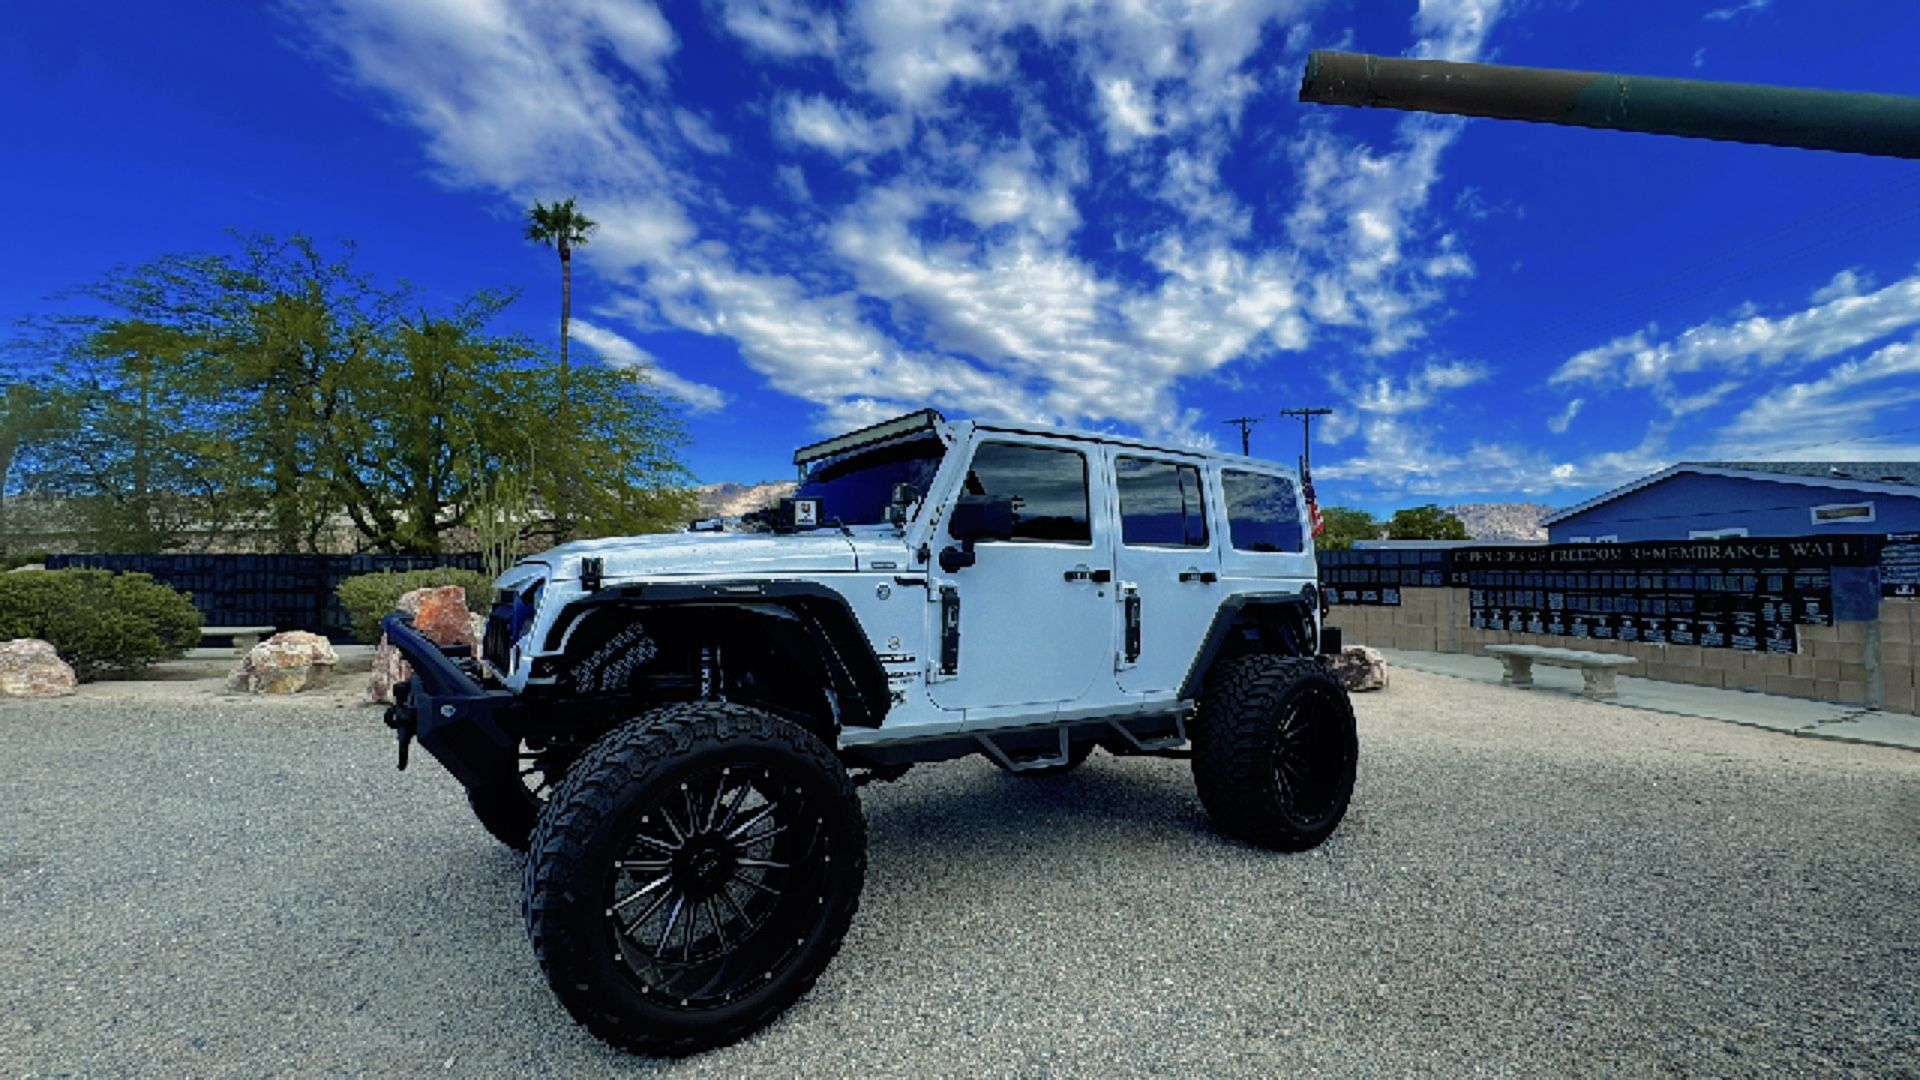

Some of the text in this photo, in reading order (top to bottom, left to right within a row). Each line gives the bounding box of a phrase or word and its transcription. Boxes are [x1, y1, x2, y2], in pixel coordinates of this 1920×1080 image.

[1550, 548, 1622, 562] FREEDOM
[1629, 544, 1780, 560] REMEMBRANCE
[1790, 542, 1858, 558] WALL
